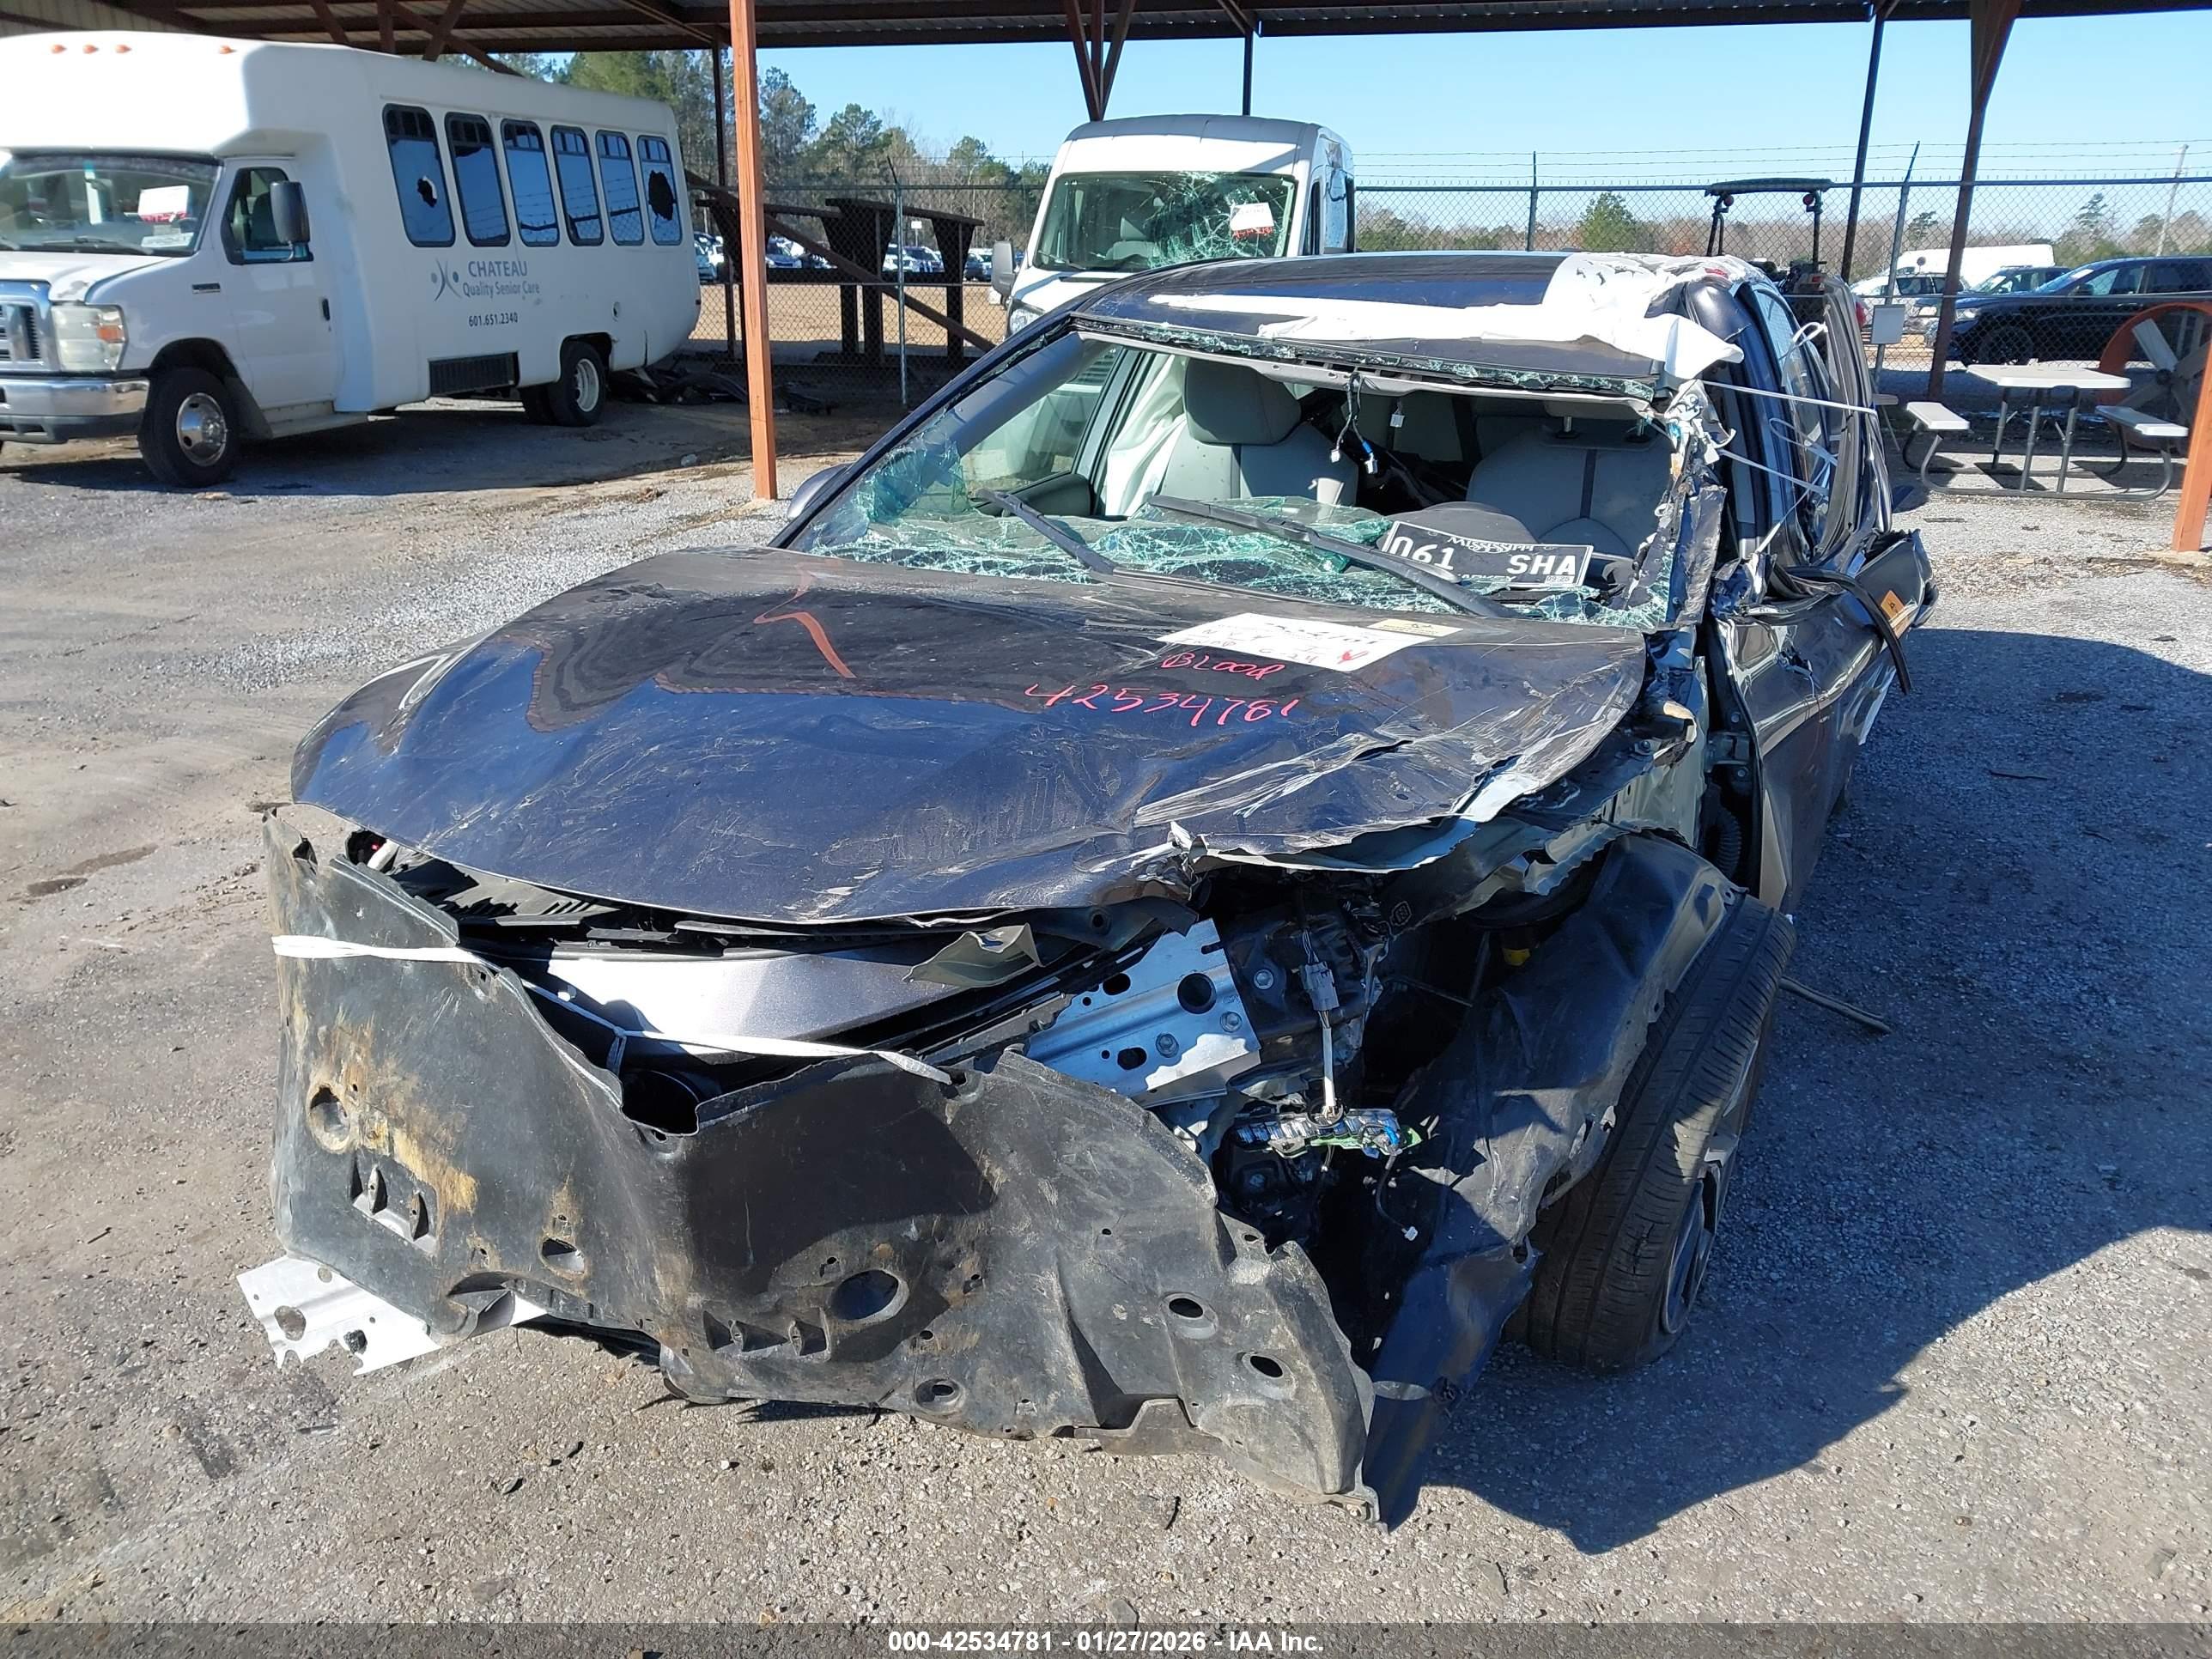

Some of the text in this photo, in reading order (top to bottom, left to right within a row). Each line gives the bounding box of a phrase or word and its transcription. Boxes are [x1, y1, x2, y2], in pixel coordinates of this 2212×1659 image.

[468, 260, 527, 277] CHATEAU
[462, 280, 540, 299] Quality Senior Care
[468, 312, 519, 327] 601.651.2340
[1448, 536, 1534, 554] MISSISSIPPI
[1507, 554, 1576, 575] SHA
[1024, 684, 1299, 726] 42534781
